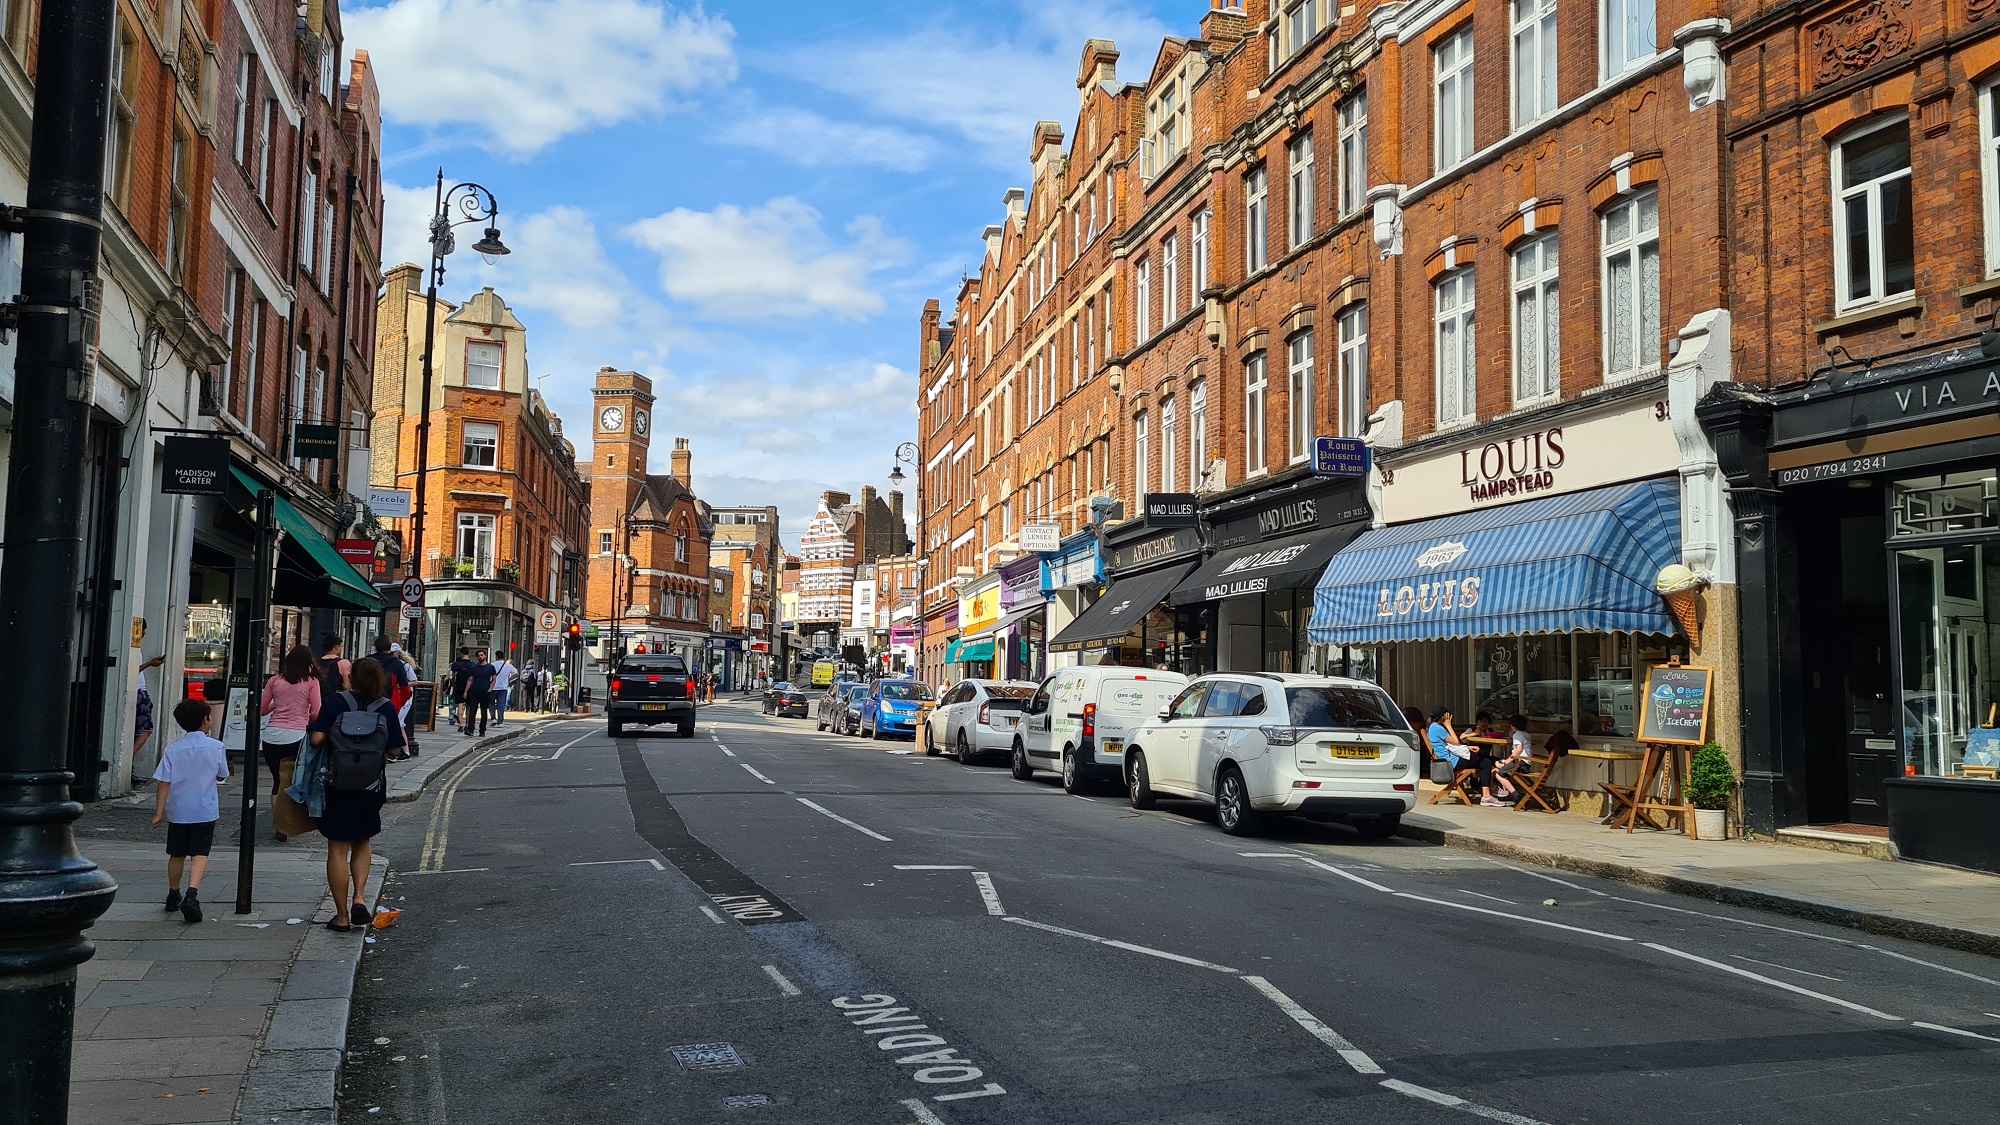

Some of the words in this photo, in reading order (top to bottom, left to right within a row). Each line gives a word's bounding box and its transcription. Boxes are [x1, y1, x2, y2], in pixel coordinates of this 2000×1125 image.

[1895, 381, 1957, 412] VIA
[1327, 440, 1356, 451] Louis
[1319, 451, 1361, 461] Patisserie
[1461, 428, 1565, 487] LOUIS
[175, 469, 217, 478] MADISON
[1320, 462, 1336, 471] Tea
[1340, 463, 1364, 472] Room
[1783, 468, 1809, 482] 020
[1814, 462, 1847, 477] 7794
[1853, 456, 1887, 472] 2341
[179, 477, 212, 485] CARTER
[1381, 470, 1395, 486] 32
[1471, 471, 1554, 502] HAMPSTEAD
[371, 494, 405, 504] Piccolo
[1150, 504, 1166, 515] MAD
[1259, 509, 1280, 533] MAD
[1281, 500, 1314, 529] LILLIES
[1133, 536, 1176, 562] ARTICHOKE
[1221, 552, 1261, 574] MAD
[1424, 552, 1454, 564] 1963
[405, 584, 422, 597] 20
[1206, 585, 1228, 597] MAD
[1377, 577, 1481, 617] LOUIS
[1336, 746, 1356, 756] DT15
[1358, 747, 1375, 756] EHY
[711, 895, 784, 919] ONLY
[831, 994, 1007, 1102] LOADING
